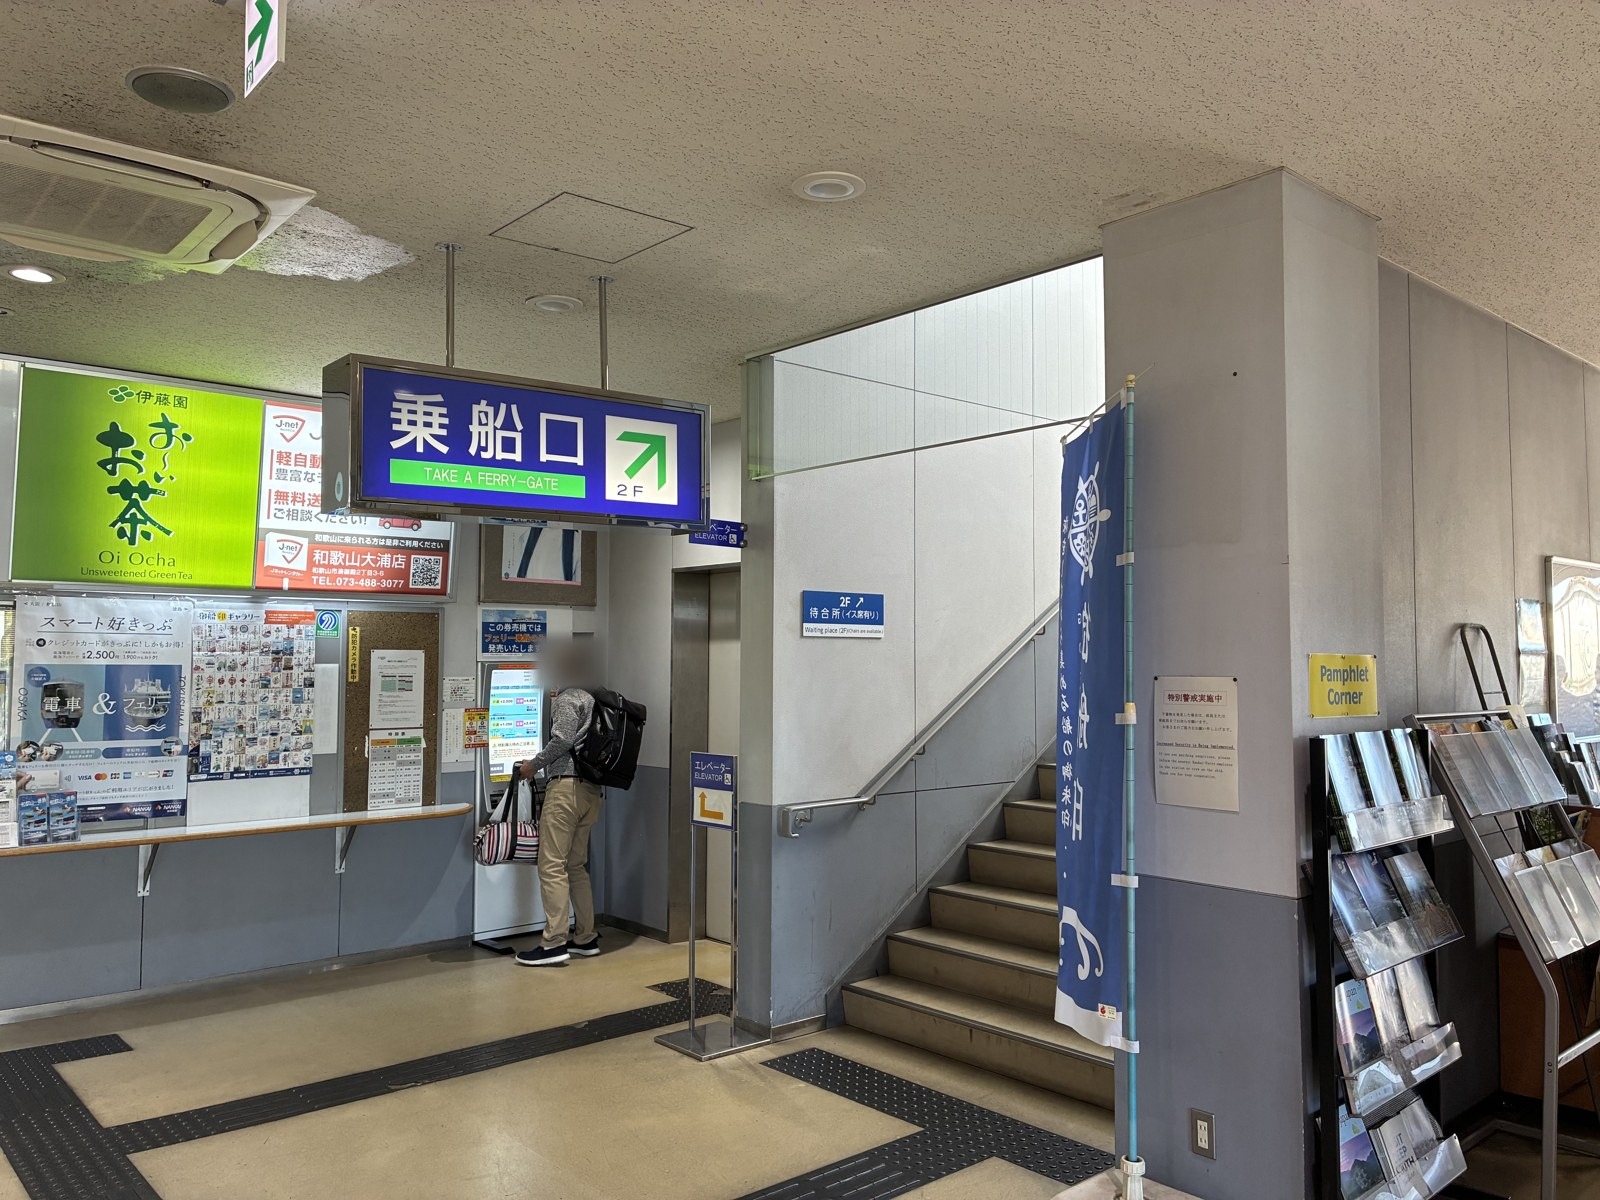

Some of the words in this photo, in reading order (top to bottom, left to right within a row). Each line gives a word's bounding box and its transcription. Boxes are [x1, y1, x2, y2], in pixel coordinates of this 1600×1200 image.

[136, 389, 188, 409] 伊藤園
[389, 392, 584, 467] 乗船口
[424, 467, 458, 483] TAKE
[464, 471, 473, 485] A
[478, 472, 559, 491] FERRY-GATE
[617, 484, 644, 498] 2F
[99, 550, 121, 564] Oi
[129, 552, 176, 567] Ocha
[313, 550, 407, 569] 和歌山大浦店
[81, 567, 146, 579] Unsweetened
[148, 570, 176, 580] Green
[177, 571, 193, 580] Tea
[312, 576, 404, 588] TEL.073-488-3077
[840, 596, 851, 607] 2F
[40, 617, 173, 631] スマート好きっぷ
[489, 623, 542, 632] この券売機では
[1320, 665, 1369, 685] Pamphlet
[43, 697, 81, 711] 電車
[92, 693, 116, 715] &
[123, 698, 171, 709] フェリー
[1168, 693, 1222, 703] 特別警戒実施中
[1328, 688, 1363, 705] Corner
[17, 687, 28, 722] OSAKA
[694, 761, 731, 773] エレベーター
[694, 772, 723, 782] ELEVATOR
